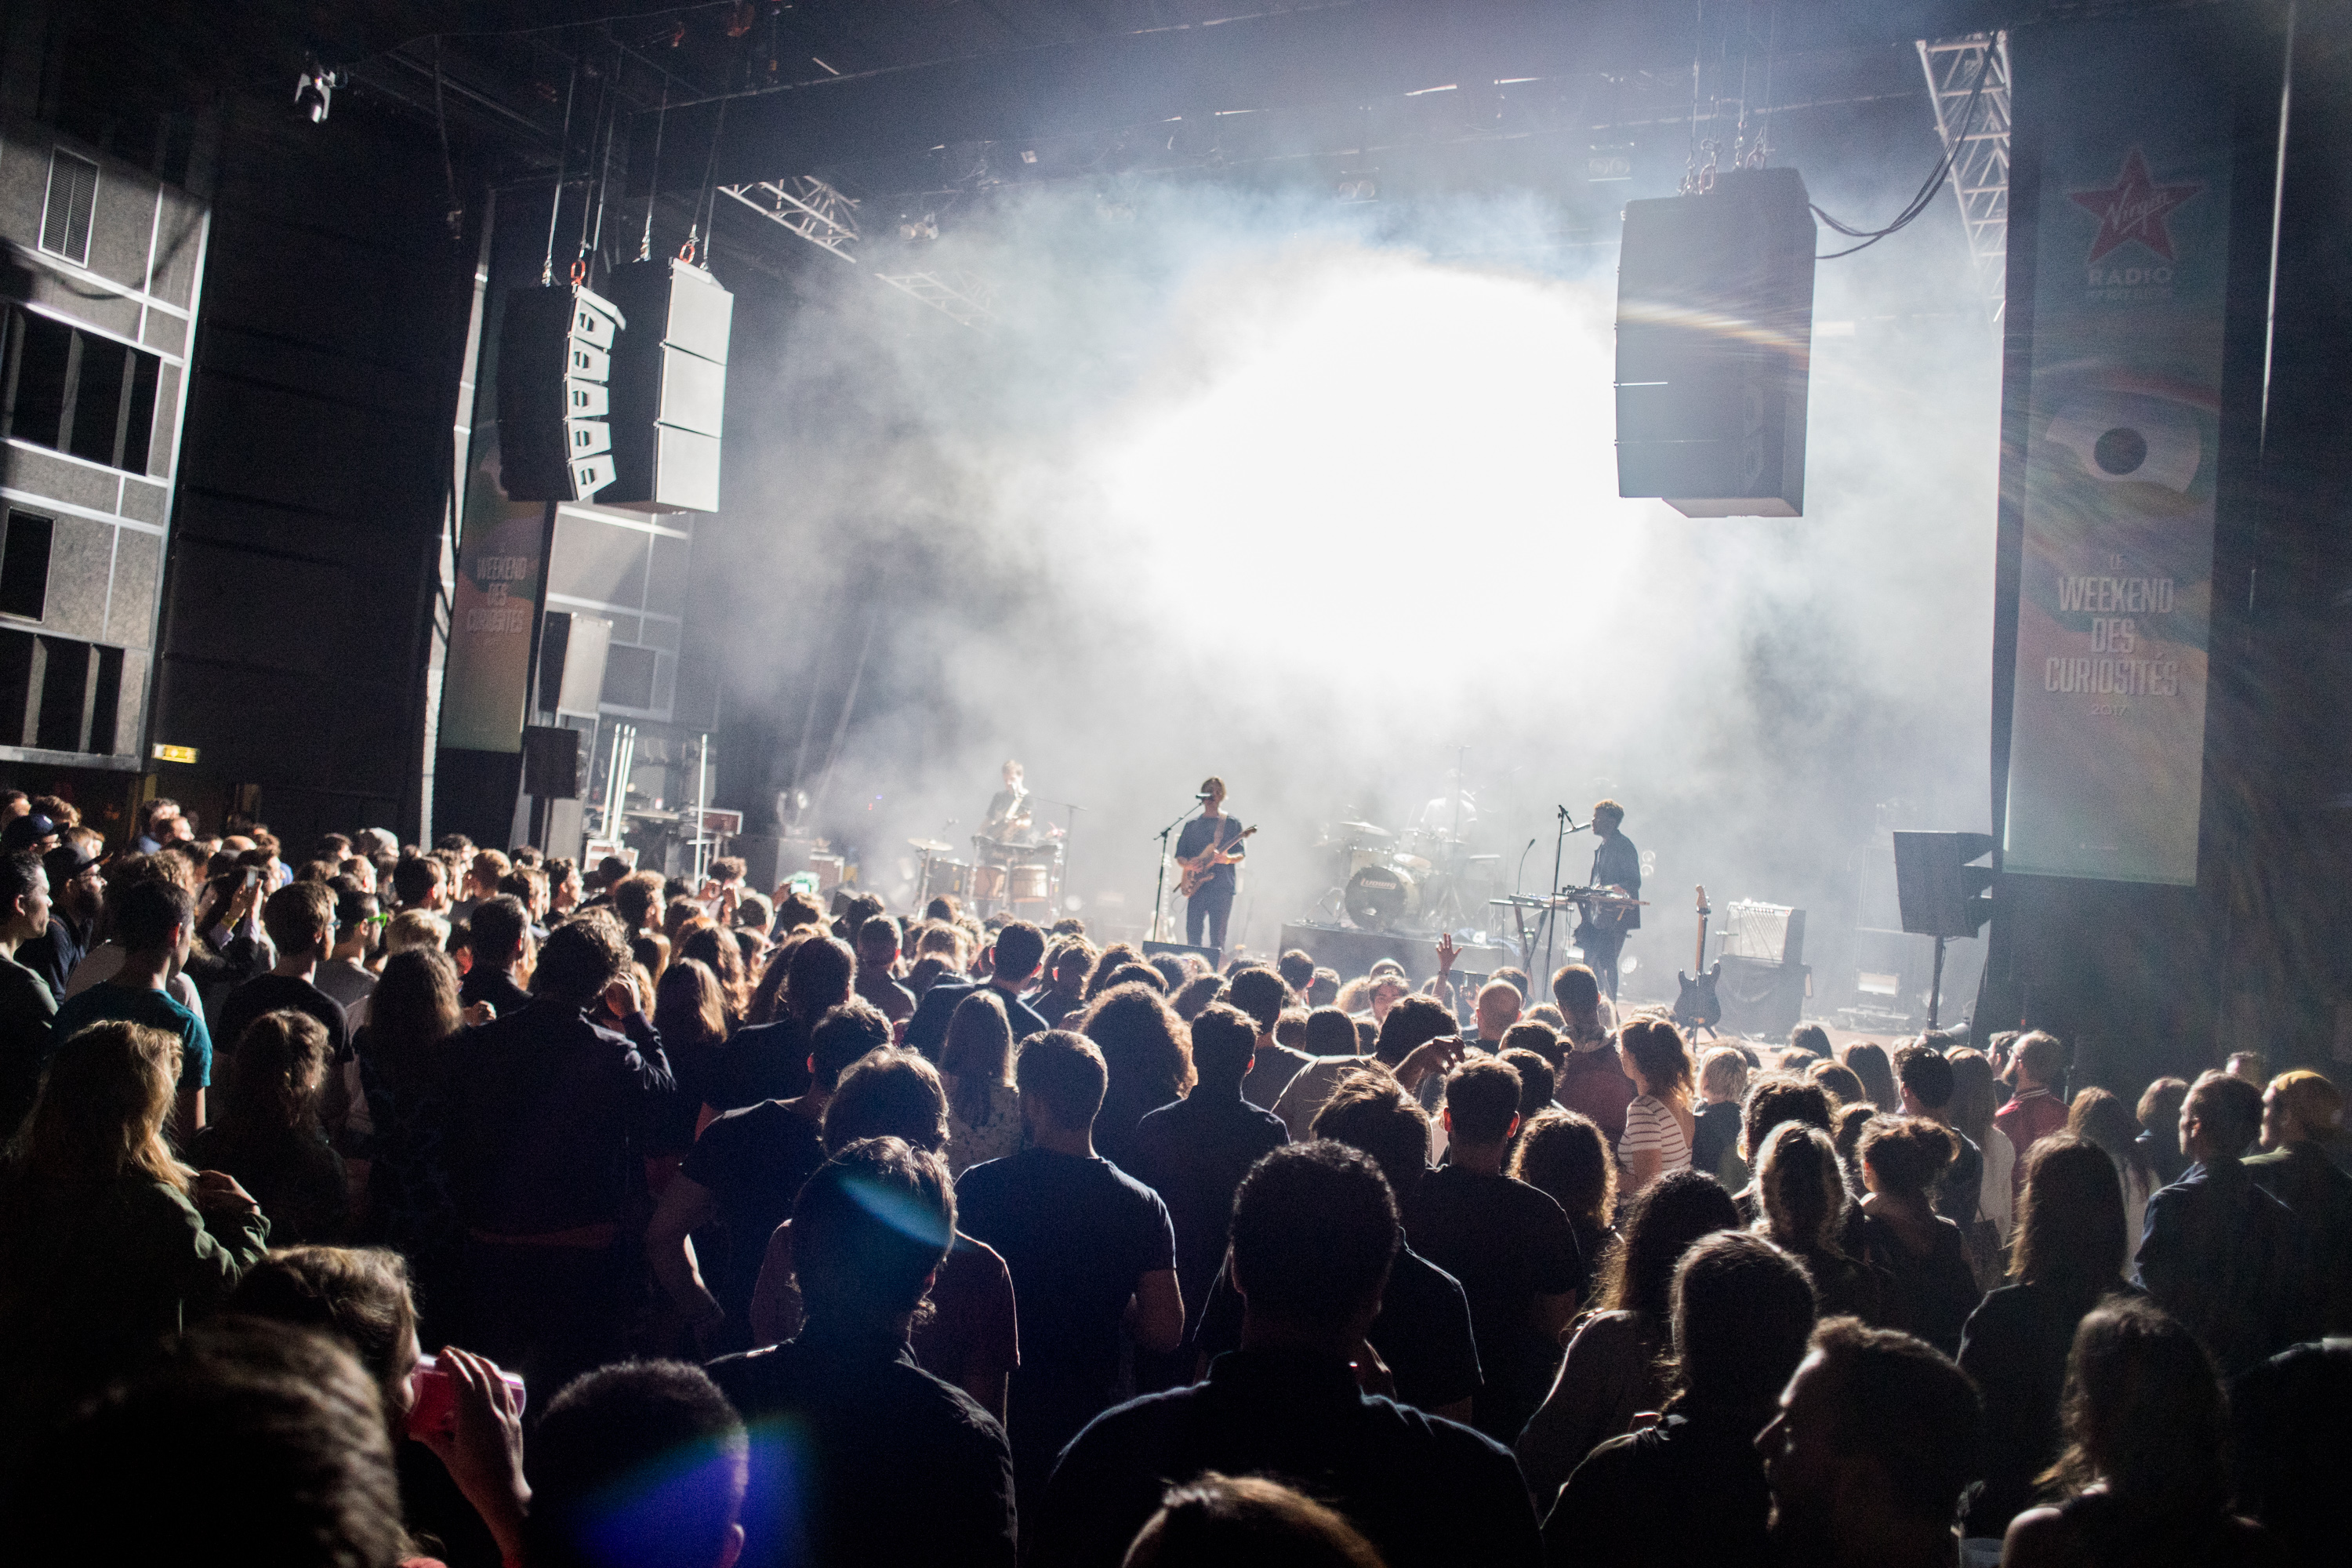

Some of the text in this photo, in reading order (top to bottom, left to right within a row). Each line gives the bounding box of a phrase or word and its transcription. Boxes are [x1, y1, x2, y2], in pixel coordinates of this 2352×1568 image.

[2087, 267, 2173, 285] RADIO
[2058, 576, 2174, 613] WEEKEND
[2090, 617, 2136, 653] DES
[2045, 653, 2180, 696] CURIOSITÉS
